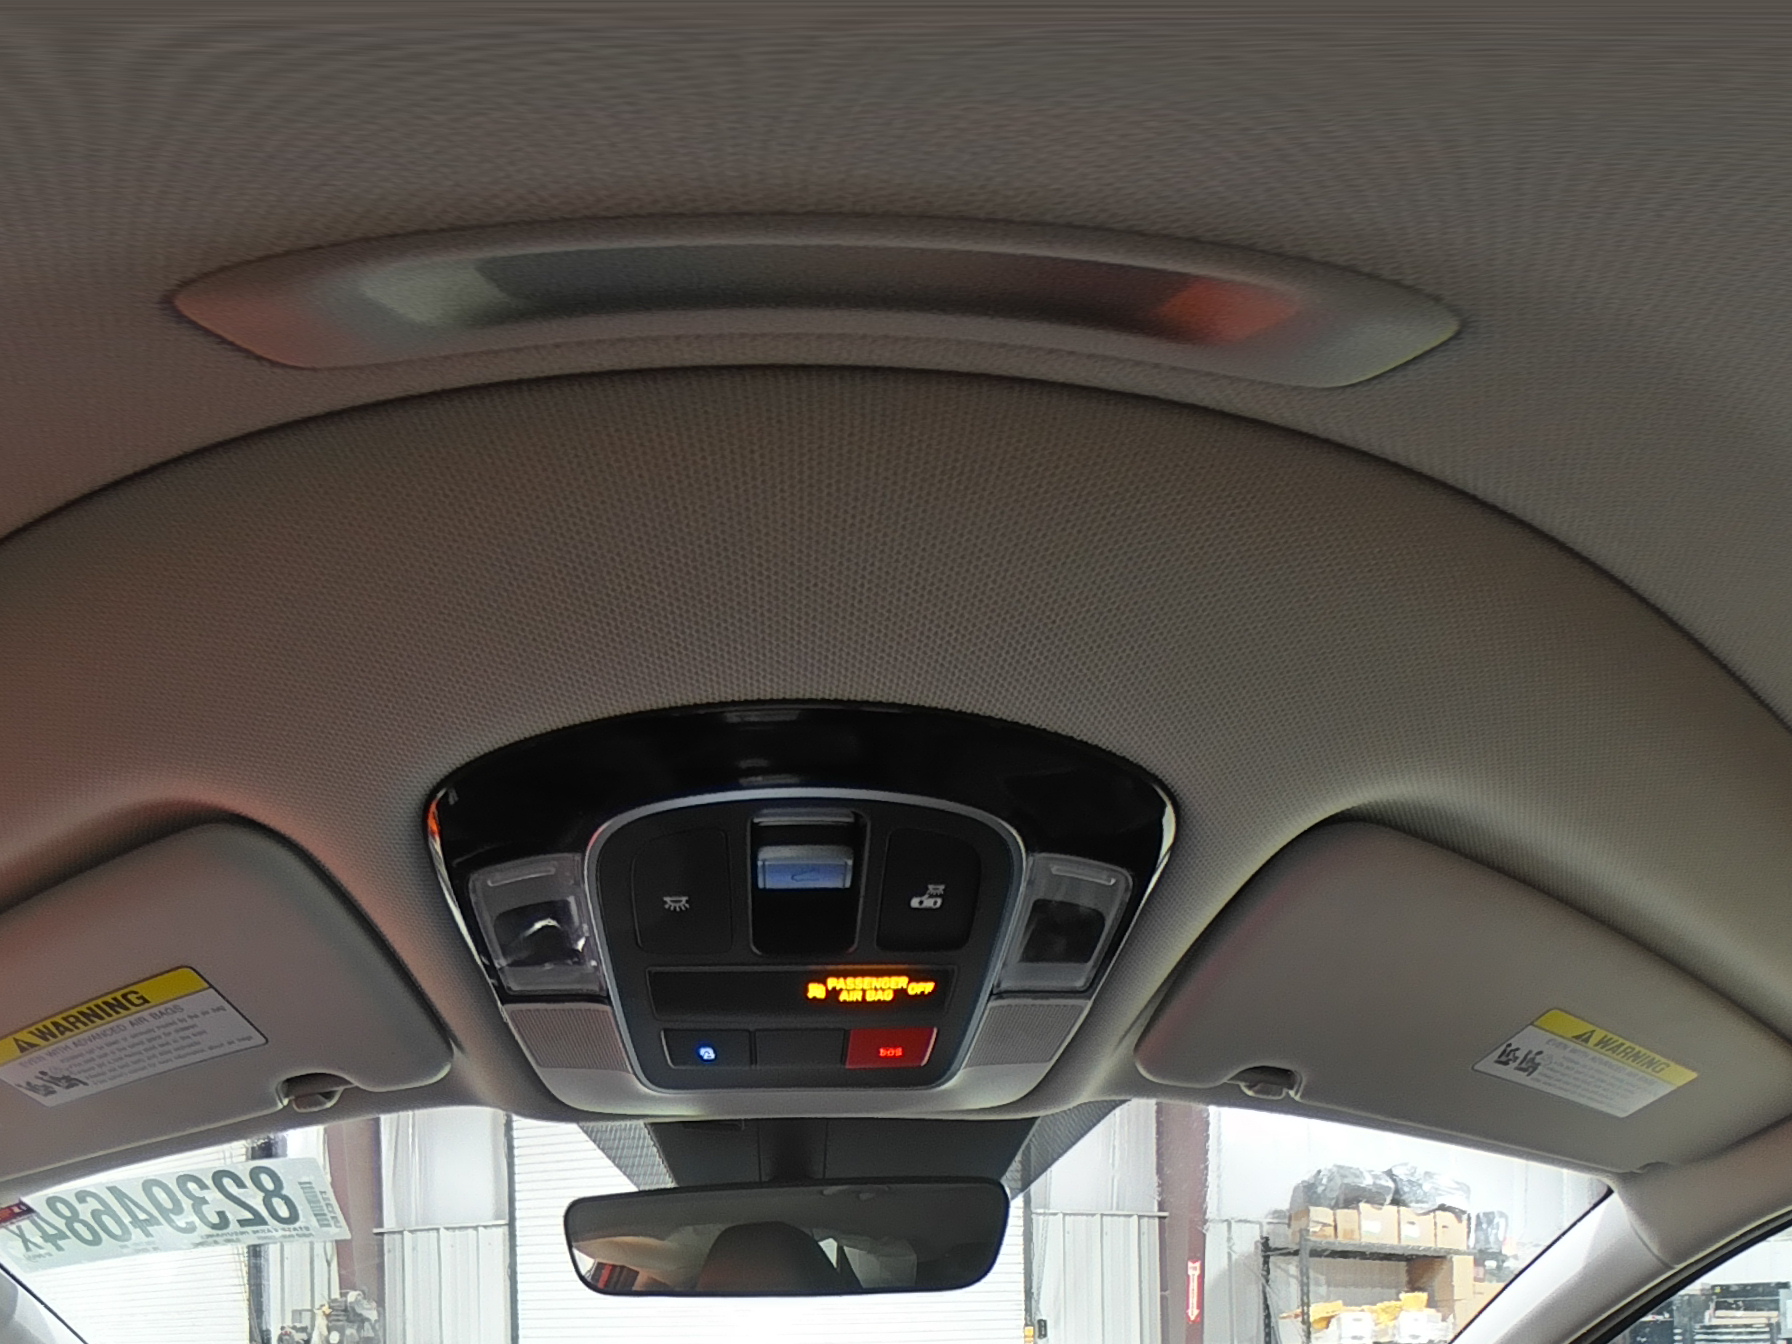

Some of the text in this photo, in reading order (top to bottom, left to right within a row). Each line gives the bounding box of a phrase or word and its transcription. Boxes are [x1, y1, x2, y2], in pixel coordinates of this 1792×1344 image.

[826, 976, 935, 995] PASSENGER OFF
[839, 990, 863, 1002] AIR
[28, 988, 152, 1043] WARNING
[72, 1023, 127, 1049] ADVANCED
[128, 1015, 148, 1031] AIR
[151, 1003, 185, 1021] BAGS
[1595, 1034, 1671, 1075] WARNING
